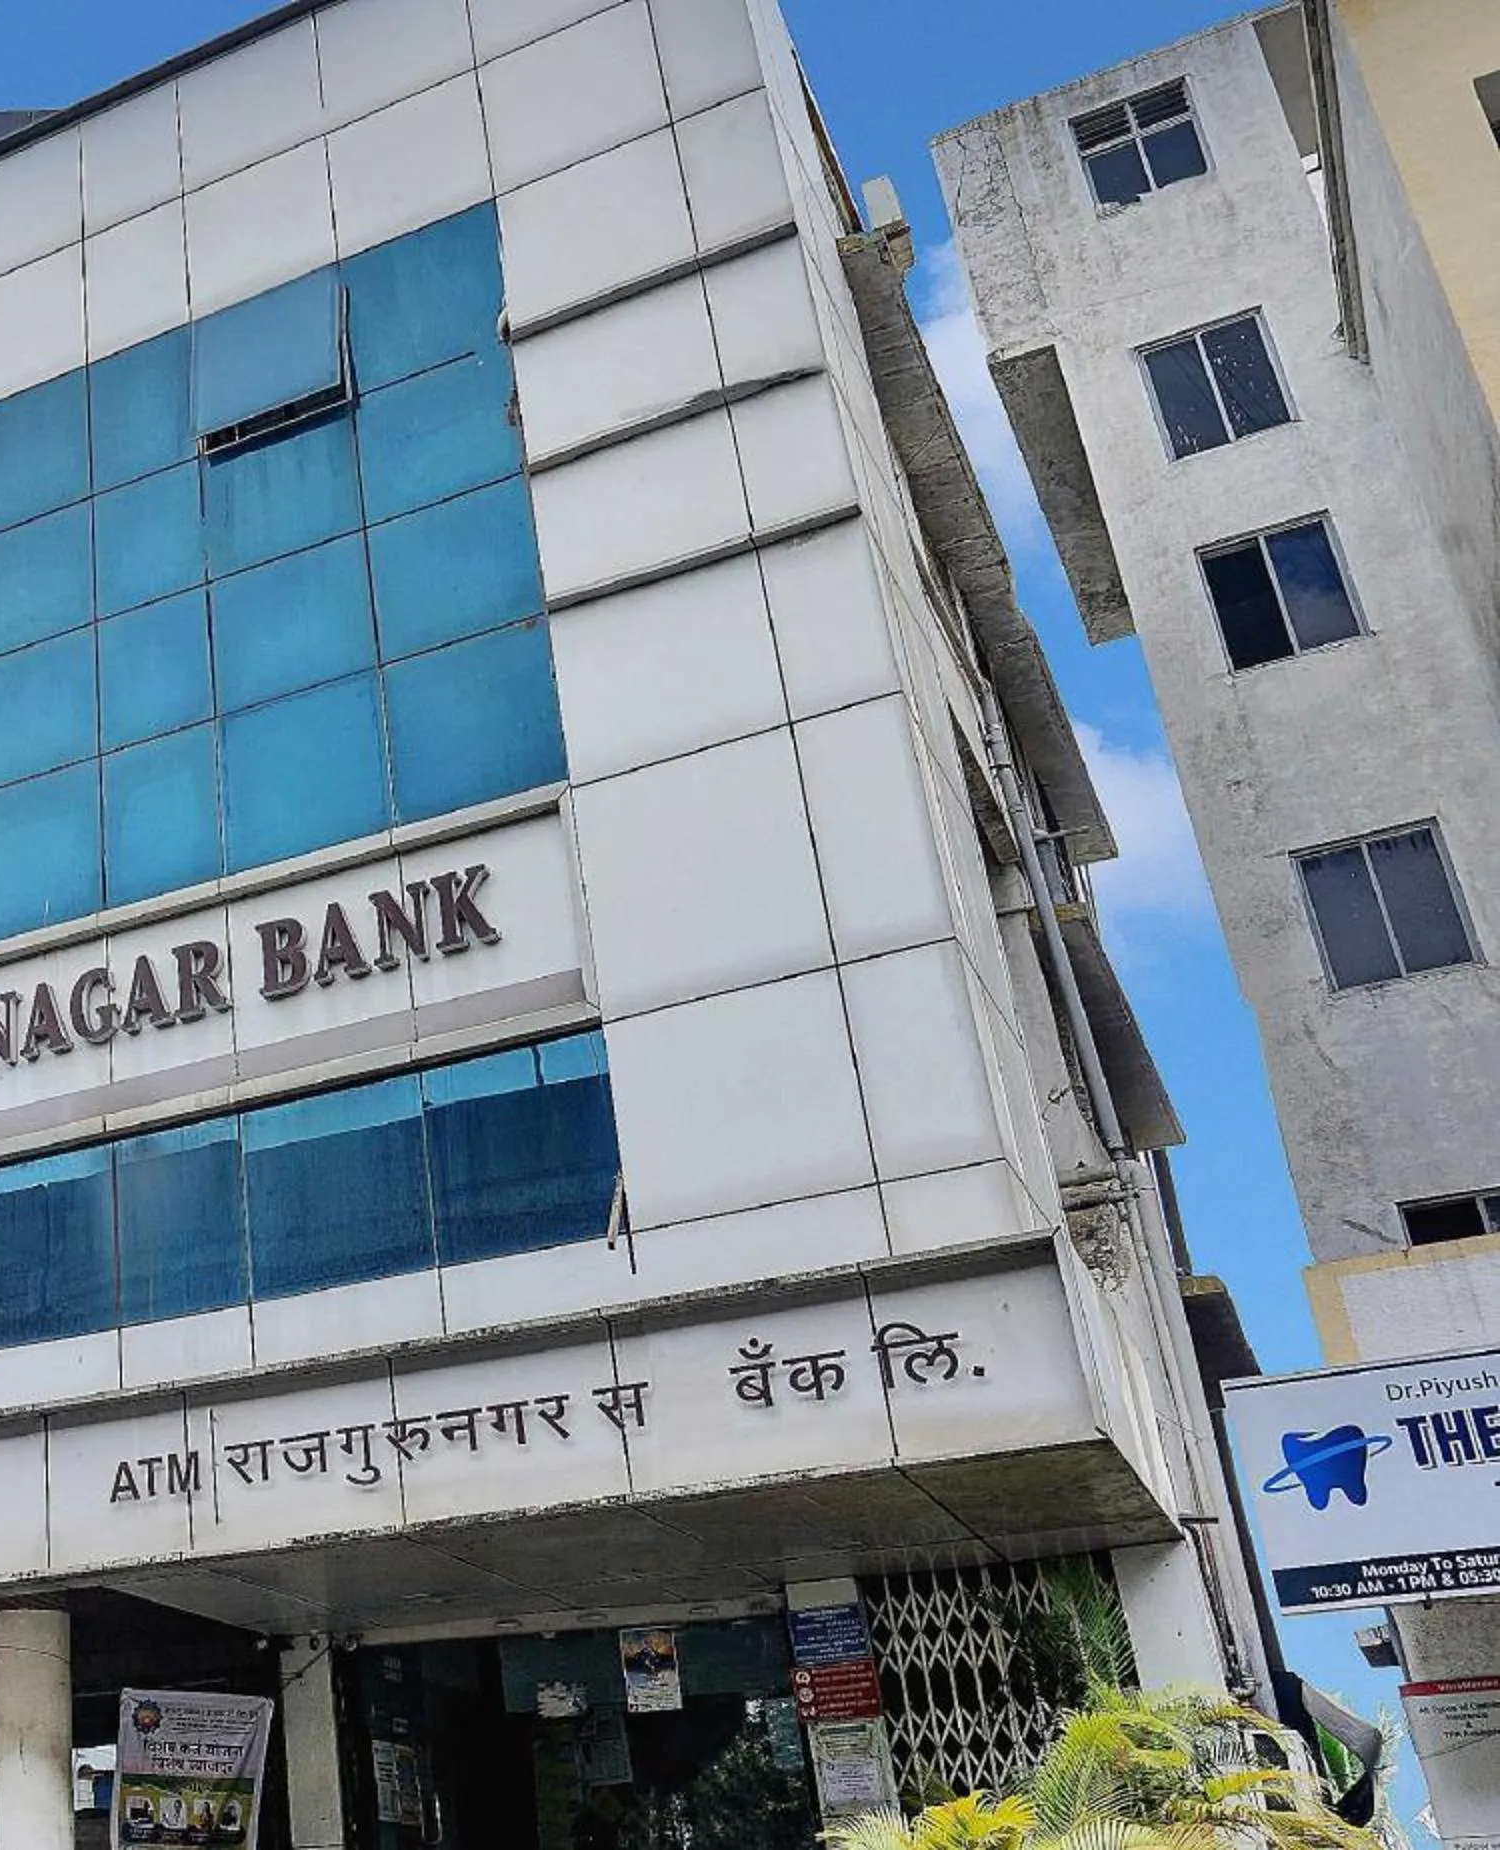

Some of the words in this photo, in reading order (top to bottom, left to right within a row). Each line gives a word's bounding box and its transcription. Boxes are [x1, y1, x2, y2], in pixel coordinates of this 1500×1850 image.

[257, 863, 501, 1001] BANK
[1385, 1371, 1499, 1401] Dr.Piyush
[1395, 1405, 1500, 1470] THE
[108, 1452, 201, 1504] ATM
[1357, 1580, 1385, 1595] AM
[1442, 1572, 1455, 1588] &
[1361, 1561, 1428, 1577] Monday
[1430, 1557, 1452, 1571] To
